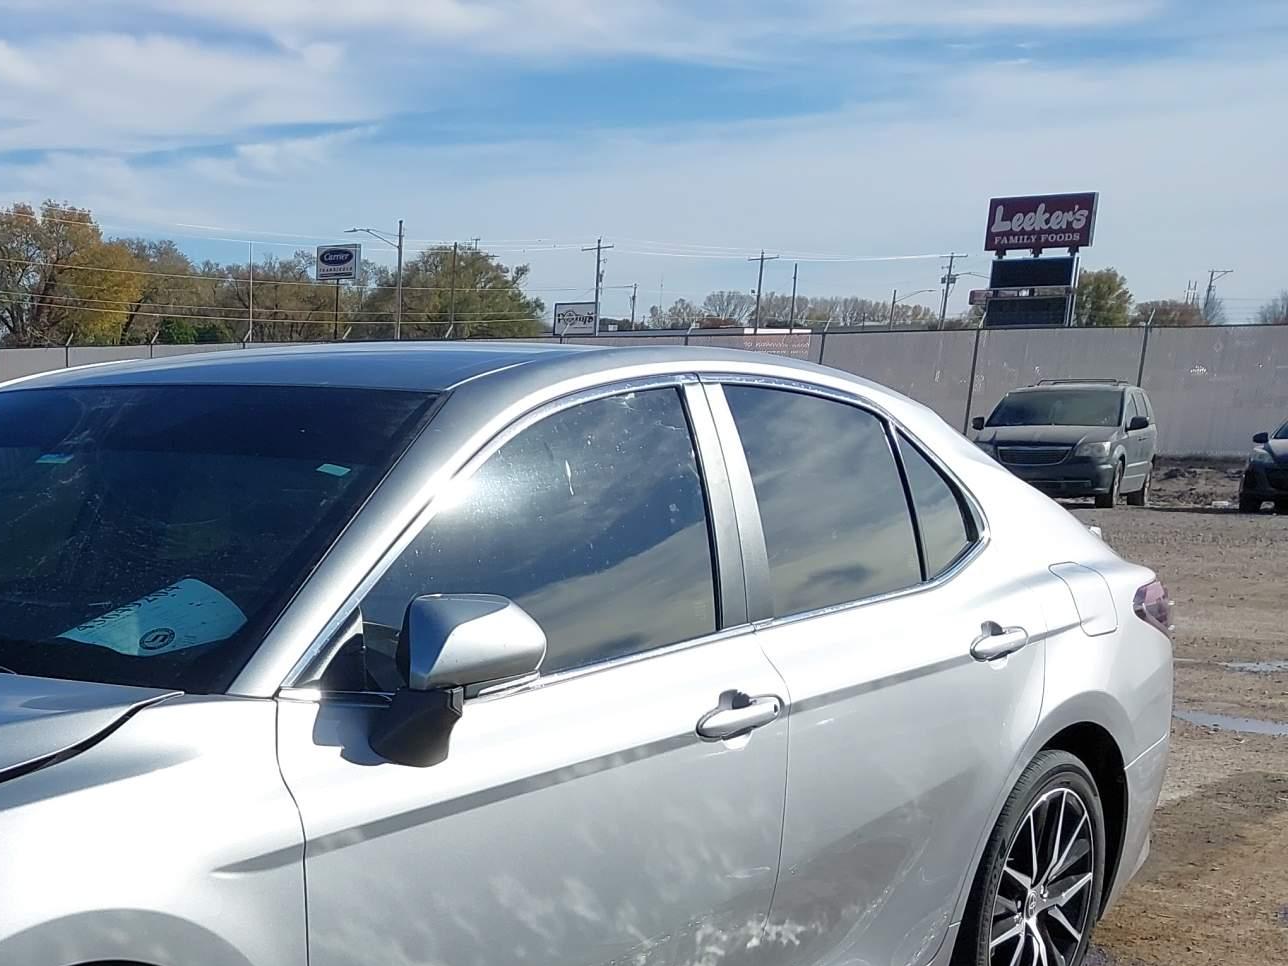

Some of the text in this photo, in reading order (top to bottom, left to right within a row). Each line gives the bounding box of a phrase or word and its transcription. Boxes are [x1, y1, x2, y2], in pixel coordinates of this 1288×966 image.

[991, 203, 1089, 233] Leeker's
[994, 232, 1081, 245] FAMILY FOODS
